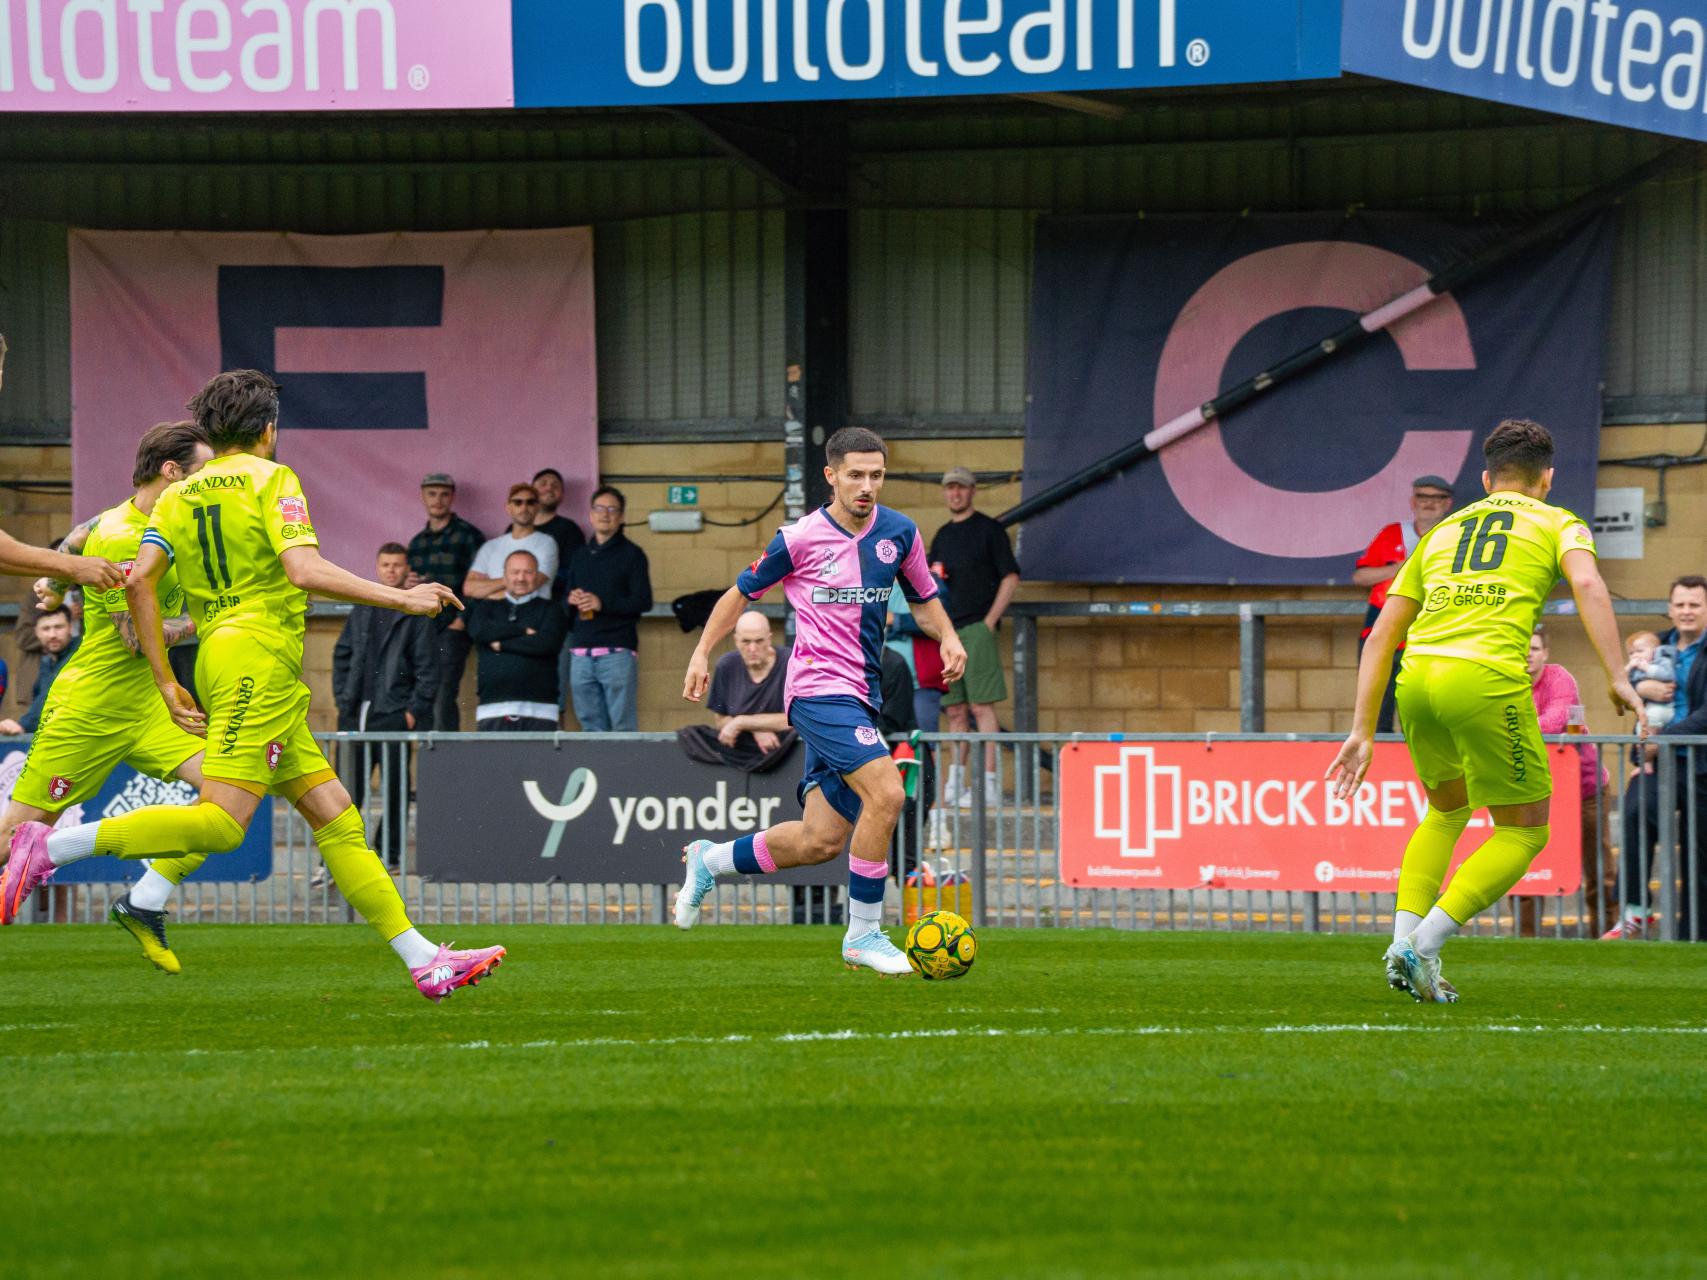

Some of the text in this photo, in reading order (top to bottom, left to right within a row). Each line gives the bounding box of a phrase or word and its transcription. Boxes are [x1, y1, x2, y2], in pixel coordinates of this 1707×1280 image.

[217, 265, 444, 430] F
[1154, 241, 1478, 559] C
[193, 504, 232, 590] 11
[1452, 511, 1514, 574] 16
[1453, 594, 1505, 607] GROUP
[1456, 584, 1507, 596] THE SB
[220, 676, 255, 756] GRUNDON
[609, 781, 781, 845] yonder
[1187, 779, 1317, 827] BRICK
